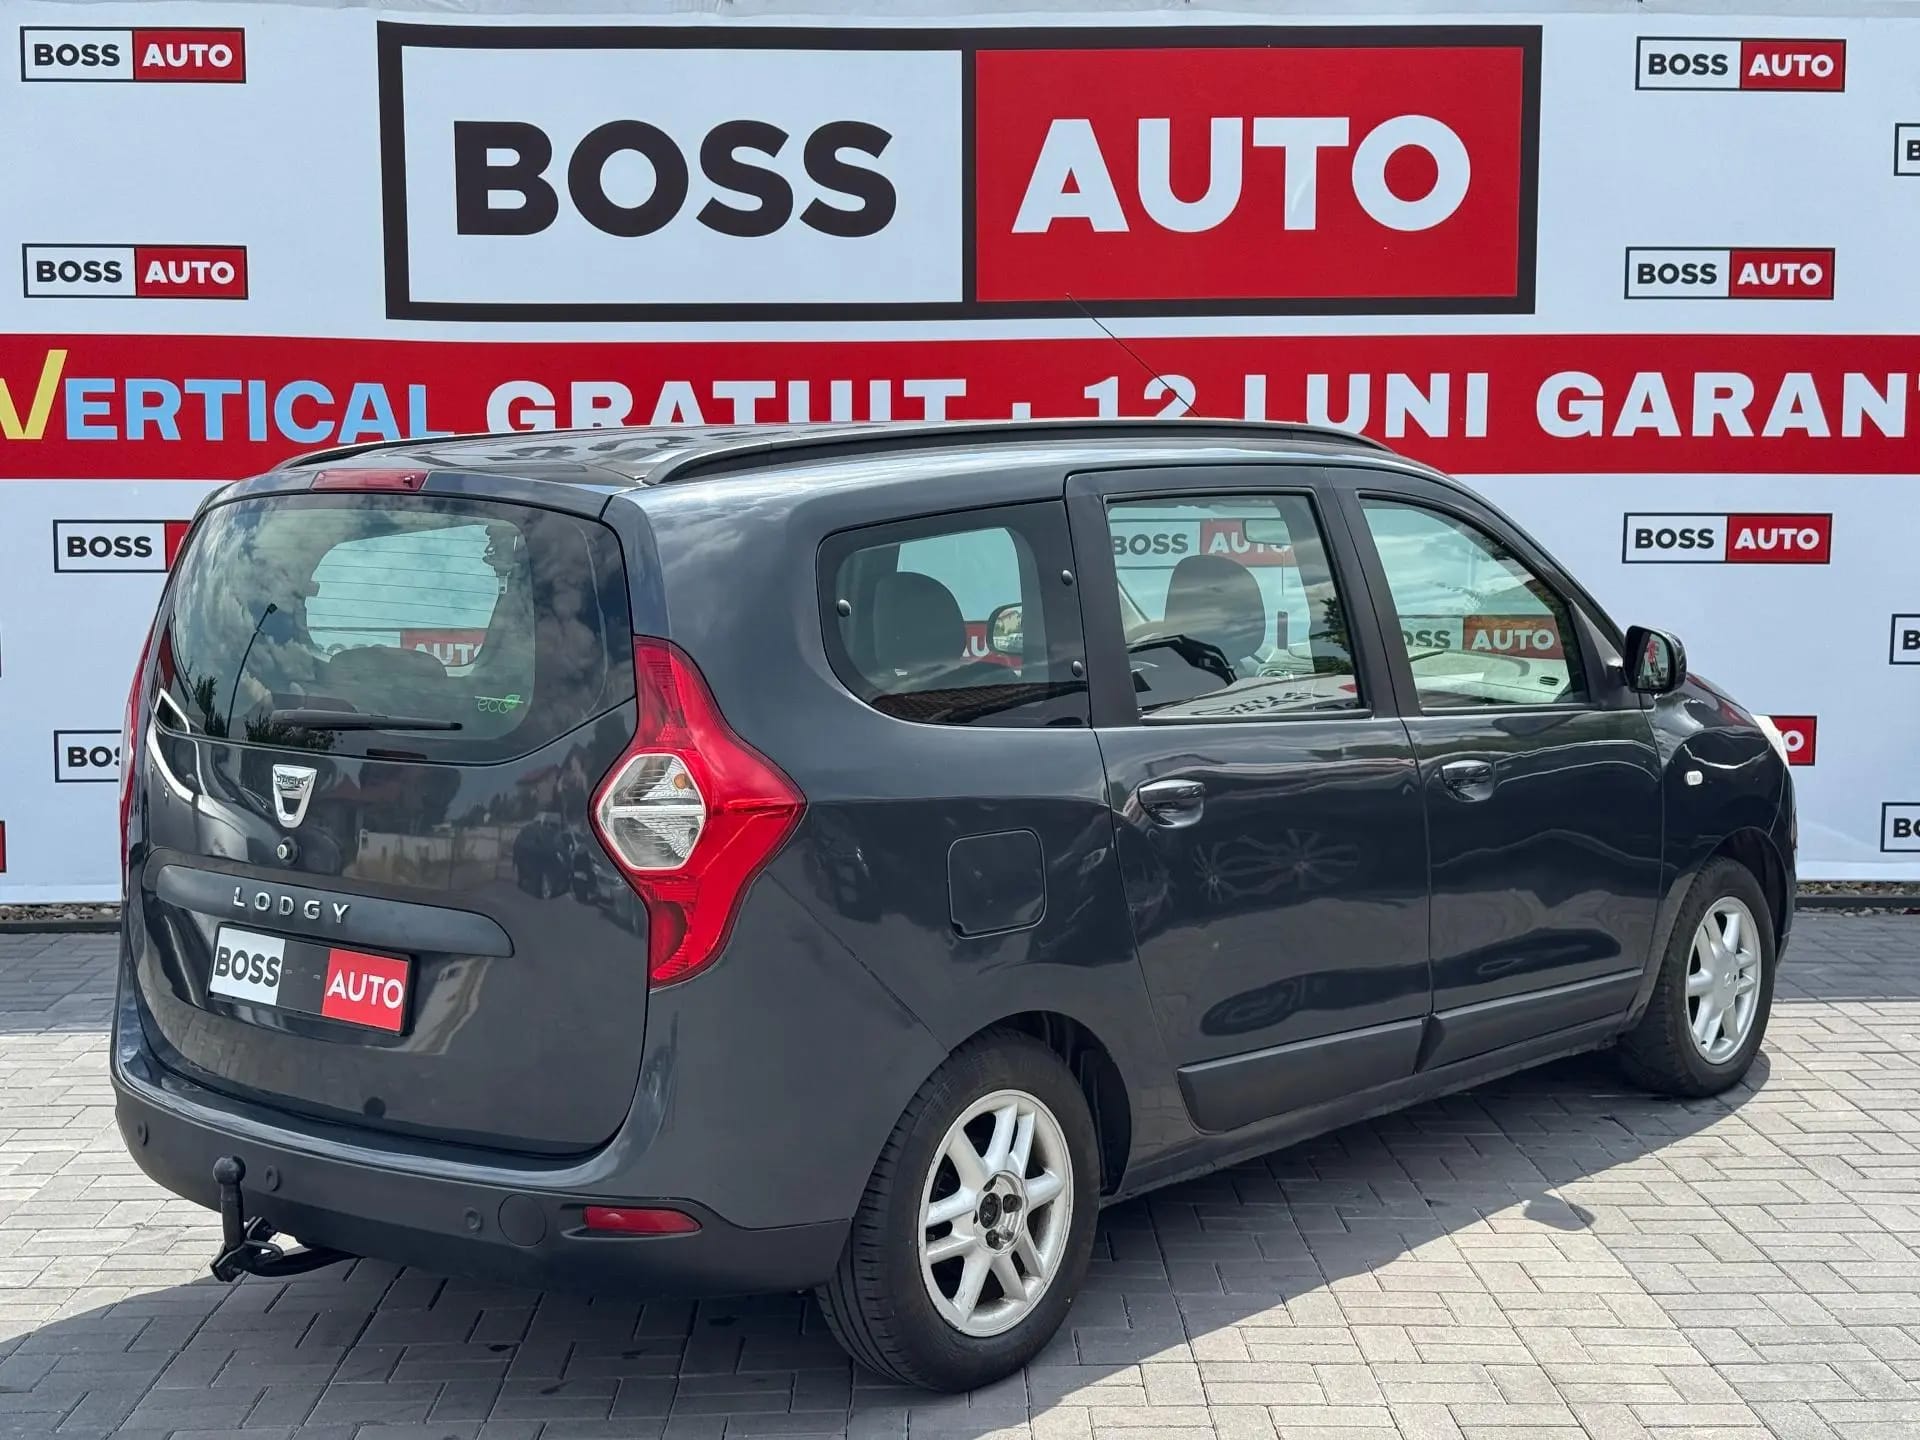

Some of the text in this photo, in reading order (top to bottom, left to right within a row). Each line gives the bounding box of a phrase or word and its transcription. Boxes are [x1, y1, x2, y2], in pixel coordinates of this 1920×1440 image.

[34, 43, 233, 68] BOSS AUTO
[1648, 53, 1834, 78] BOSS AUTO
[454, 114, 1471, 238] BOSS AUTO
[36, 260, 235, 285] BOSS AUTO
[1637, 262, 1823, 286] BOSS AUTO
[0, 349, 456, 442] VERTICAL
[1084, 375, 1197, 419] 12
[1536, 372, 1920, 438] GARAN
[67, 535, 153, 558] BOSS
[1112, 533, 1189, 556] BOSS
[1635, 528, 1820, 550] BOSS AUTO
[1471, 628, 1555, 650] AUTO
[232, 886, 350, 923] LODGY
[214, 946, 404, 1009] BOSS AUTO
